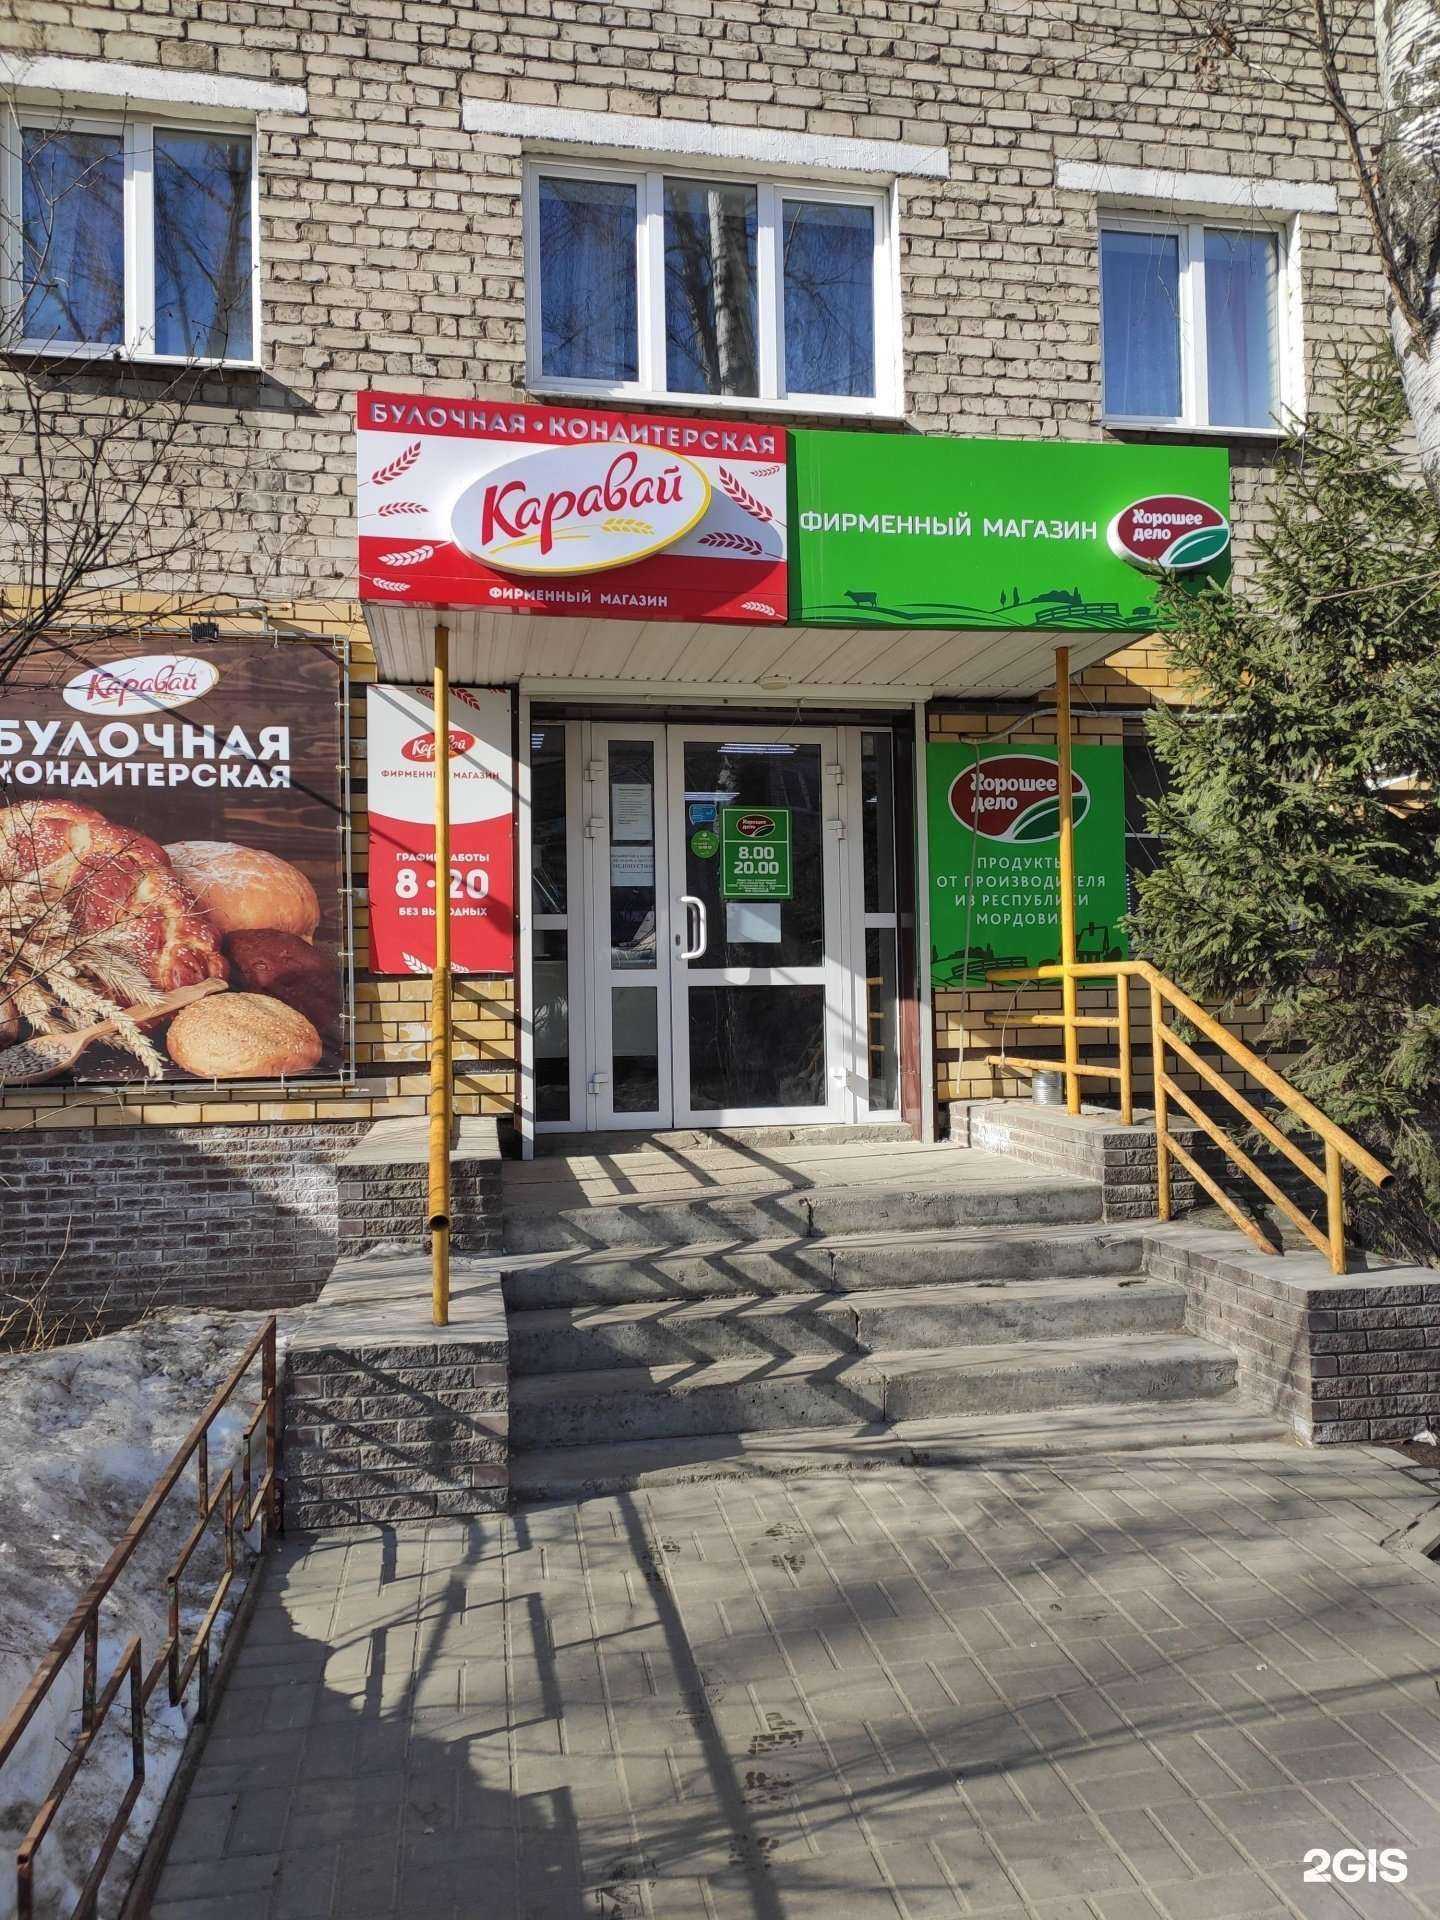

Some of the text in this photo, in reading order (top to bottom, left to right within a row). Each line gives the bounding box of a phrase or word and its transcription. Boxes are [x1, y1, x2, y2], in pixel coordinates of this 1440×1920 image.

[371, 402, 776, 455] БУЛОЧНАЯ КОНДИТЕРСКАЯ
[481, 451, 684, 555] Каравай
[800, 511, 1098, 541] ФИРМЕННЫЙ МАГАЗИН
[1132, 508, 1203, 527] Хорошее
[1132, 527, 1172, 542] дело
[489, 586, 668, 608] ФИРМЕННЫЙ МАГАЗИН
[87, 664, 197, 707] Каравай
[0, 719, 290, 760] БУЛОЧНАЯ
[411, 734, 466, 759] Карвай
[381, 770, 499, 780] ФИРМЕНН МАГАЗИН
[970, 773, 1057, 795] Хорошее
[970, 796, 1018, 813] дело
[449, 853, 490, 862] АБОТЫ
[738, 846, 775, 860] 8.00
[733, 861, 780, 875] 20.00
[936, 876, 1105, 890] ОТ ПРОИЗВОДИЕЛЯ
[955, 894, 1088, 906] ИЗ РЕСПУБЛИИ
[399, 907, 418, 916] БЕЗ
[976, 913, 1060, 927] МОРДОВИ
